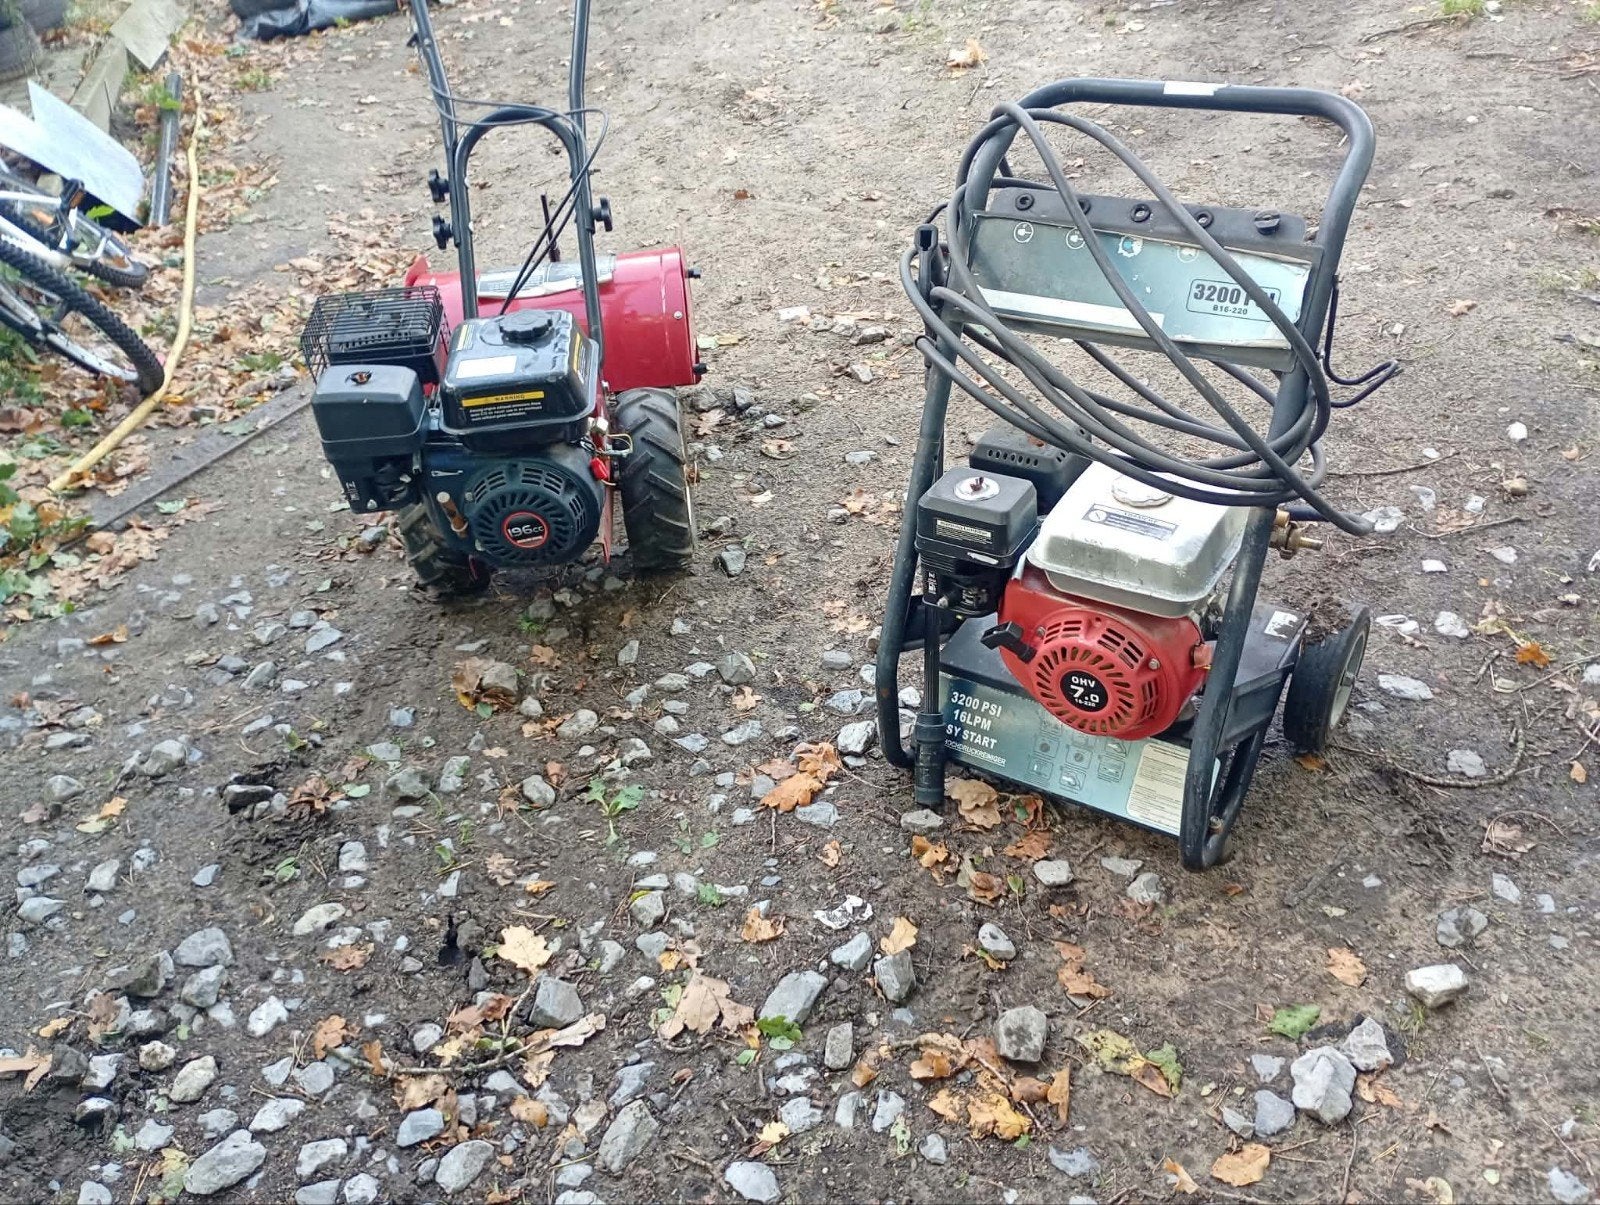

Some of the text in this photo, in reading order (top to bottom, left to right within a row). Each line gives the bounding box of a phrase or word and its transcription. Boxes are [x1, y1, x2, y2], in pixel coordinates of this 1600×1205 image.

[1193, 283, 1242, 305] 3200
[1071, 675, 1096, 688] OHV
[951, 691, 1002, 718] 3200 PSI
[1070, 684, 1100, 703] 7.0
[953, 708, 992, 732] 16LPM
[945, 723, 998, 750] SY START
